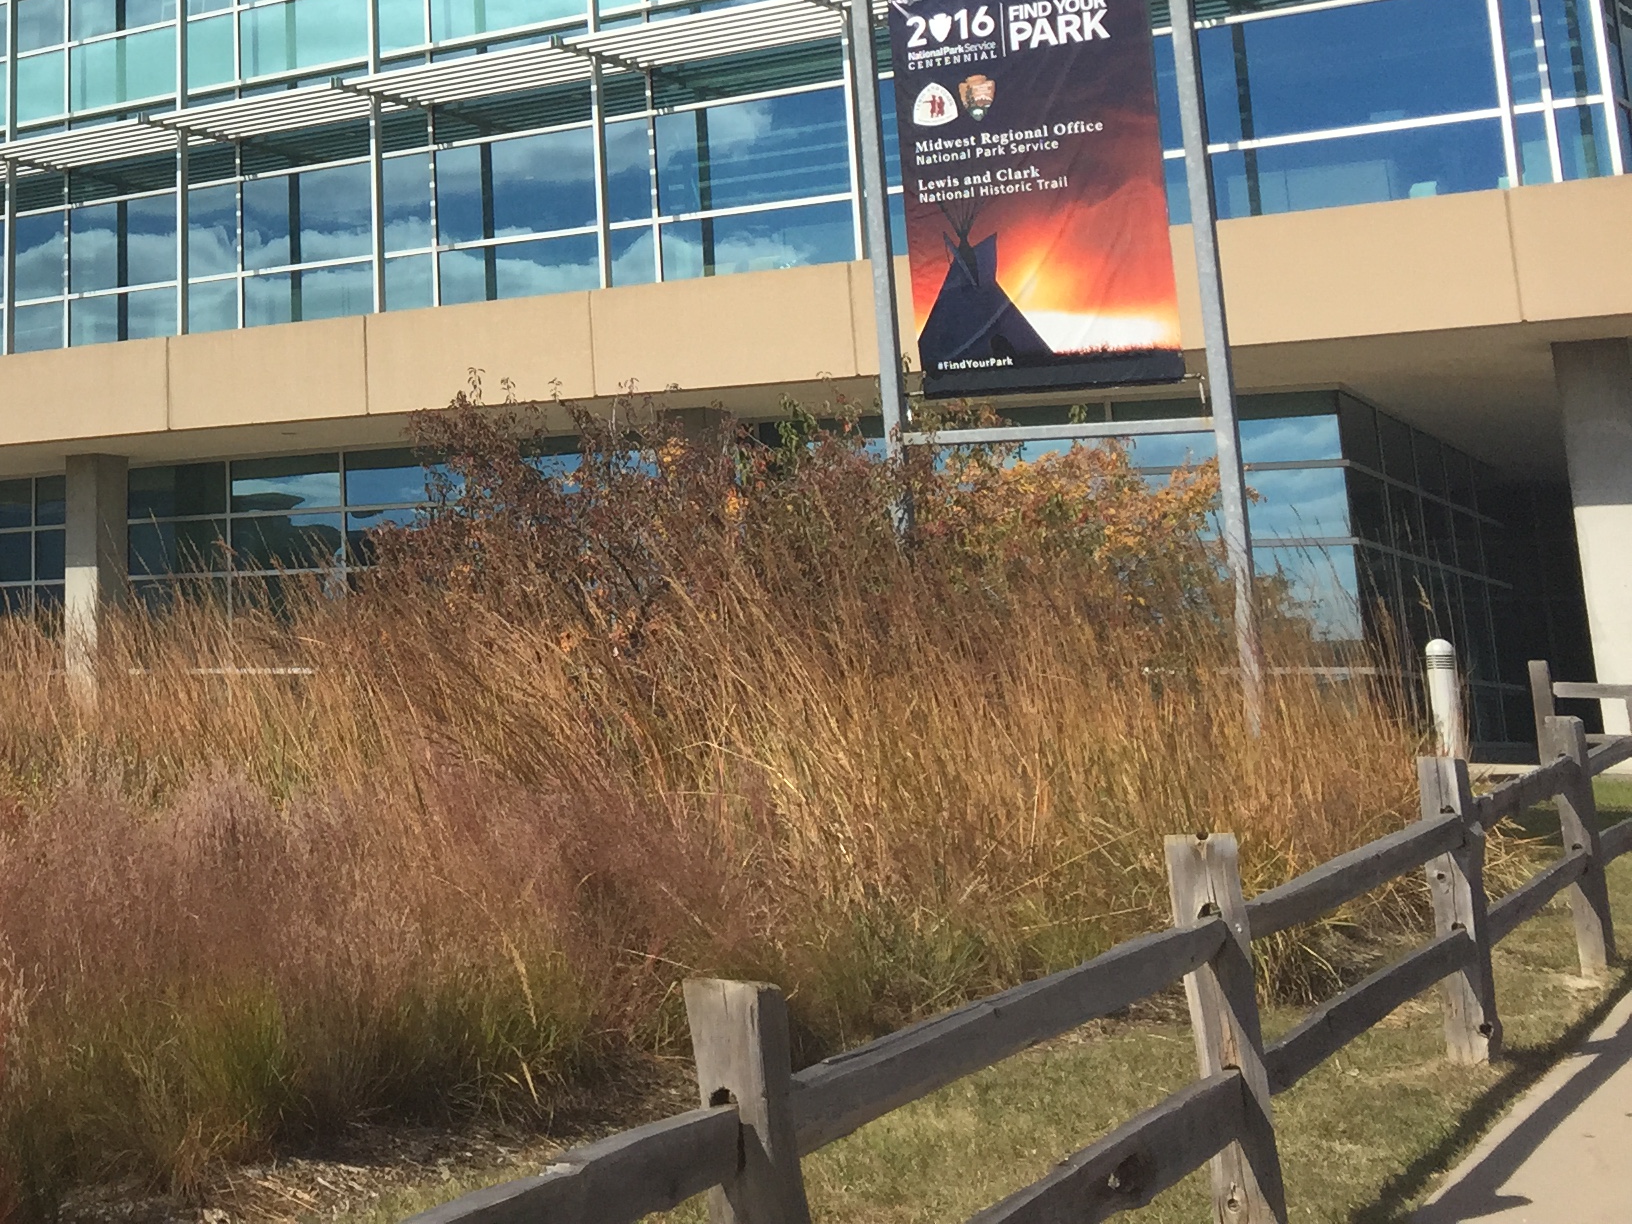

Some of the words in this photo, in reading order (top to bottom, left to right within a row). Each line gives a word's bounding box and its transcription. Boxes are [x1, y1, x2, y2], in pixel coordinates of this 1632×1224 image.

[1008, 0, 1052, 21] FIND
[1009, 8, 1111, 51] PARK
[908, 50, 997, 70] CENTENNIAL
[915, 135, 976, 153] Midwest
[981, 125, 1048, 145] Regional
[1053, 120, 1103, 136] Office
[916, 148, 971, 165] National
[976, 144, 1005, 158] Park
[1010, 139, 1059, 154] Service
[918, 175, 959, 191] Lewis
[964, 170, 991, 186] and
[996, 165, 1040, 181] Clark
[919, 186, 974, 203] National
[980, 180, 1032, 196] Historic
[1036, 176, 1068, 190] Trail
[937, 356, 1013, 370] #FindYourPark
